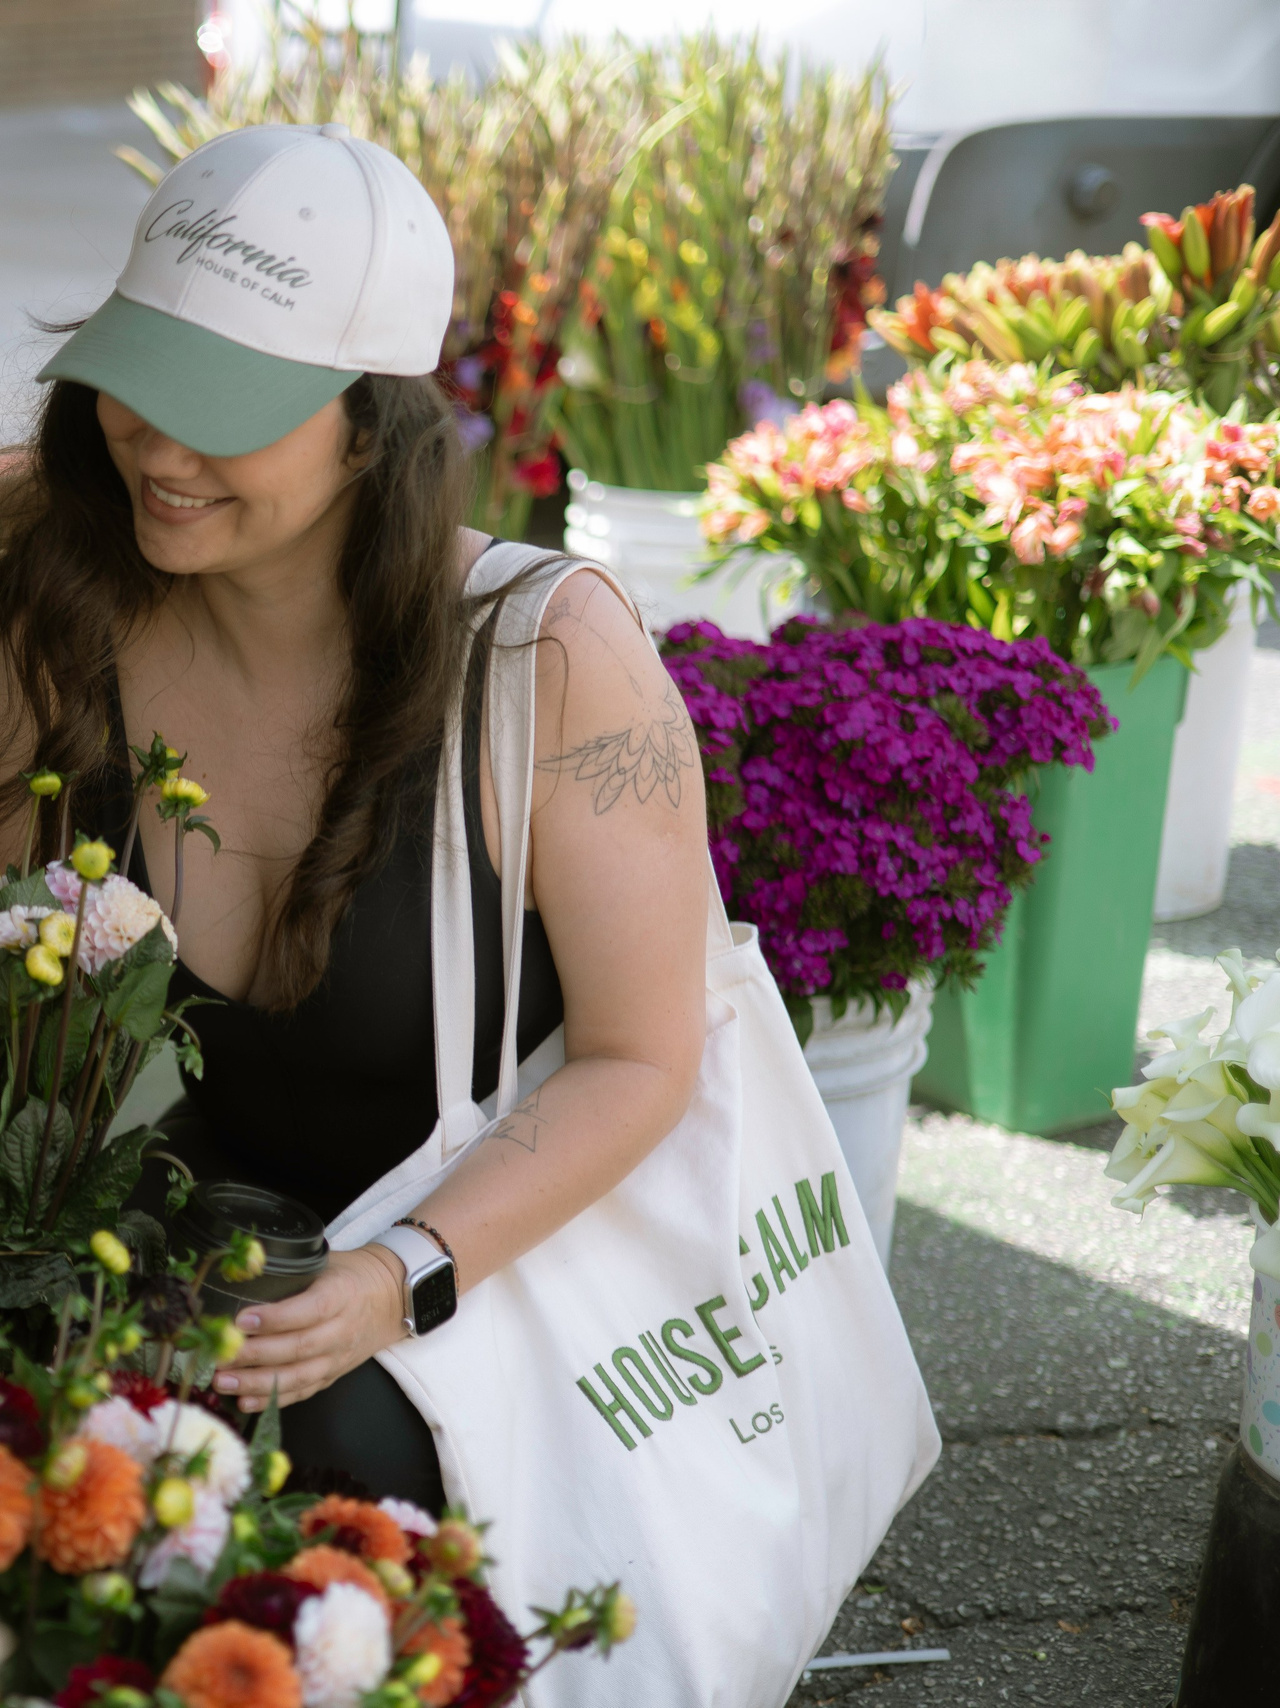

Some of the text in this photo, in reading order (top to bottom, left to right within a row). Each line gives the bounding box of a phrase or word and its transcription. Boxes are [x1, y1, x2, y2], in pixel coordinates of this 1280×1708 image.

[144, 199, 313, 288] California
[196, 257, 296, 311] HOUSE OF CALM
[576, 1294, 767, 1451] HOUSE
